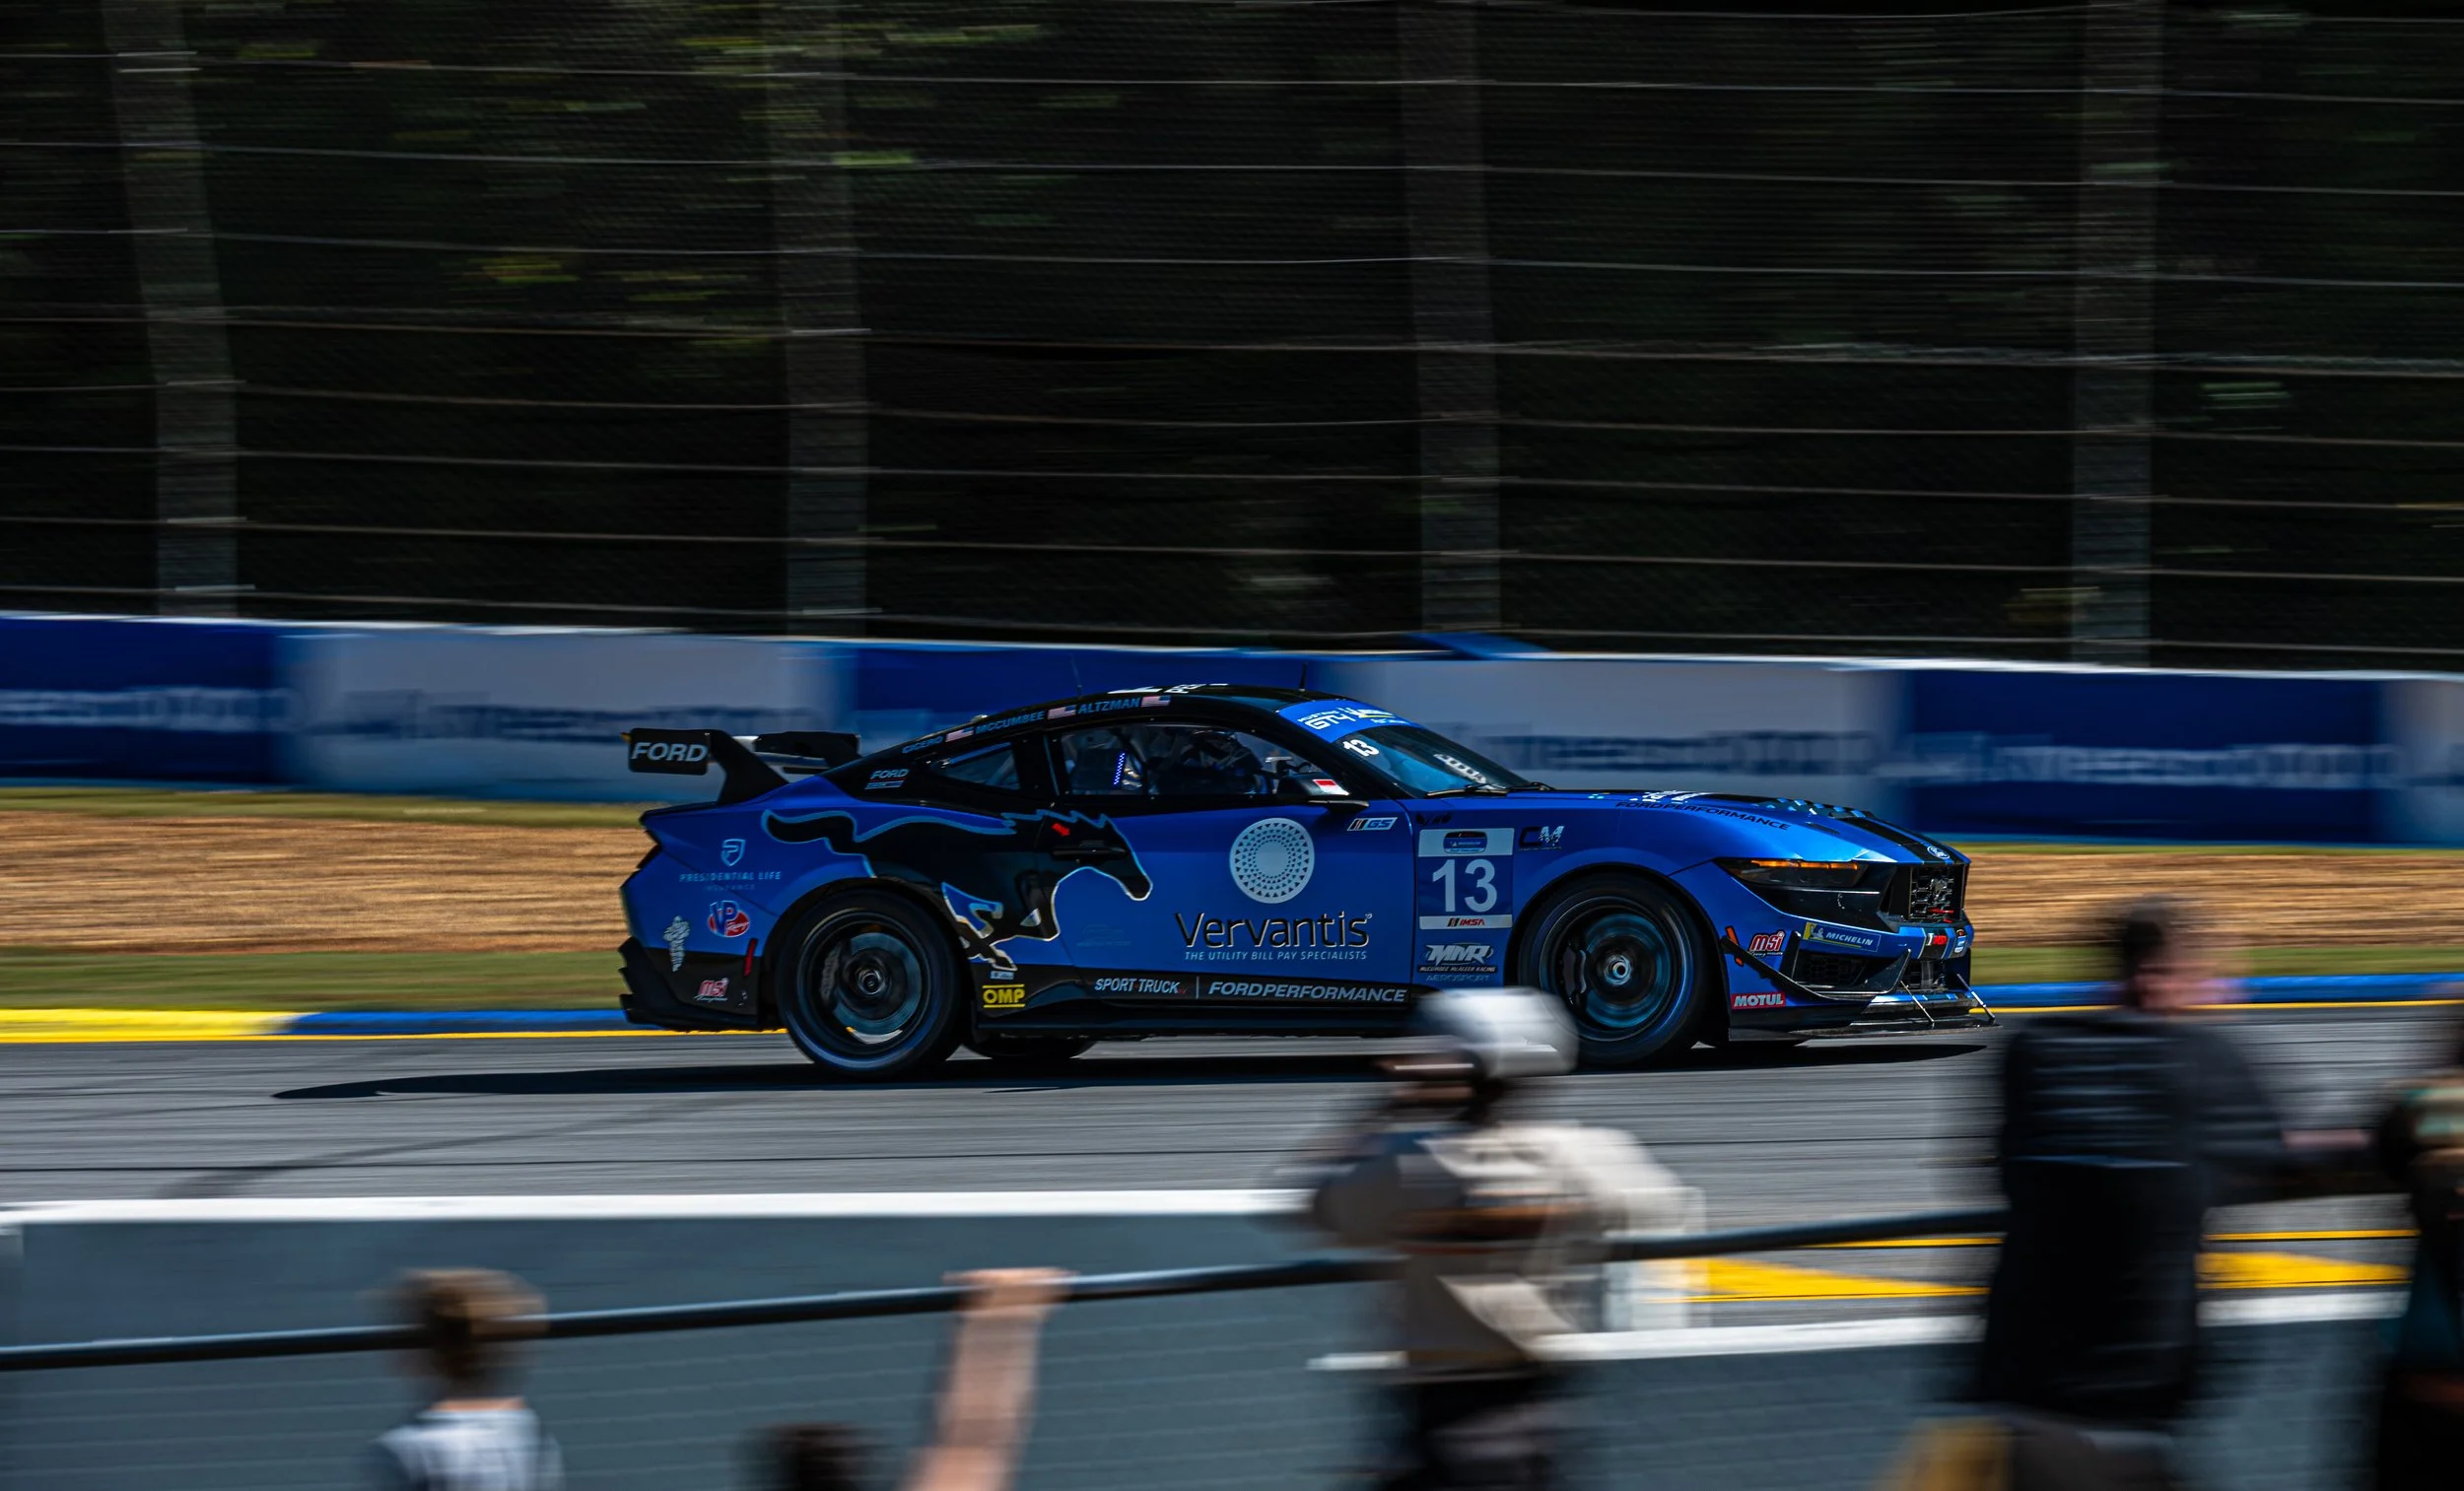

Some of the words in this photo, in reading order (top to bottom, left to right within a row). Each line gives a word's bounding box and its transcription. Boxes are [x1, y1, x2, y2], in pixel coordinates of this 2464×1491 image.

[1078, 697, 1141, 714] ALTZMAN
[631, 742, 709, 762] FORD
[1343, 739, 1380, 757] 13
[870, 769, 910, 779] FORD
[1366, 819, 1393, 829] GS
[758, 871, 782, 880] LIFE
[1432, 858, 1497, 913] 13
[1826, 931, 1874, 946] MICHELIN
[1185, 951, 1203, 961] THE
[1208, 951, 1248, 961] UTILITY
[1251, 951, 1273, 961] BILL
[1277, 951, 1296, 961] PAY
[1301, 950, 1368, 960] SPECIALISTS
[1094, 978, 1137, 991] SPORT
[1138, 979, 1181, 994] TRUCK
[983, 988, 1026, 1004] OMP
[1734, 993, 1784, 1007] MOTUL
